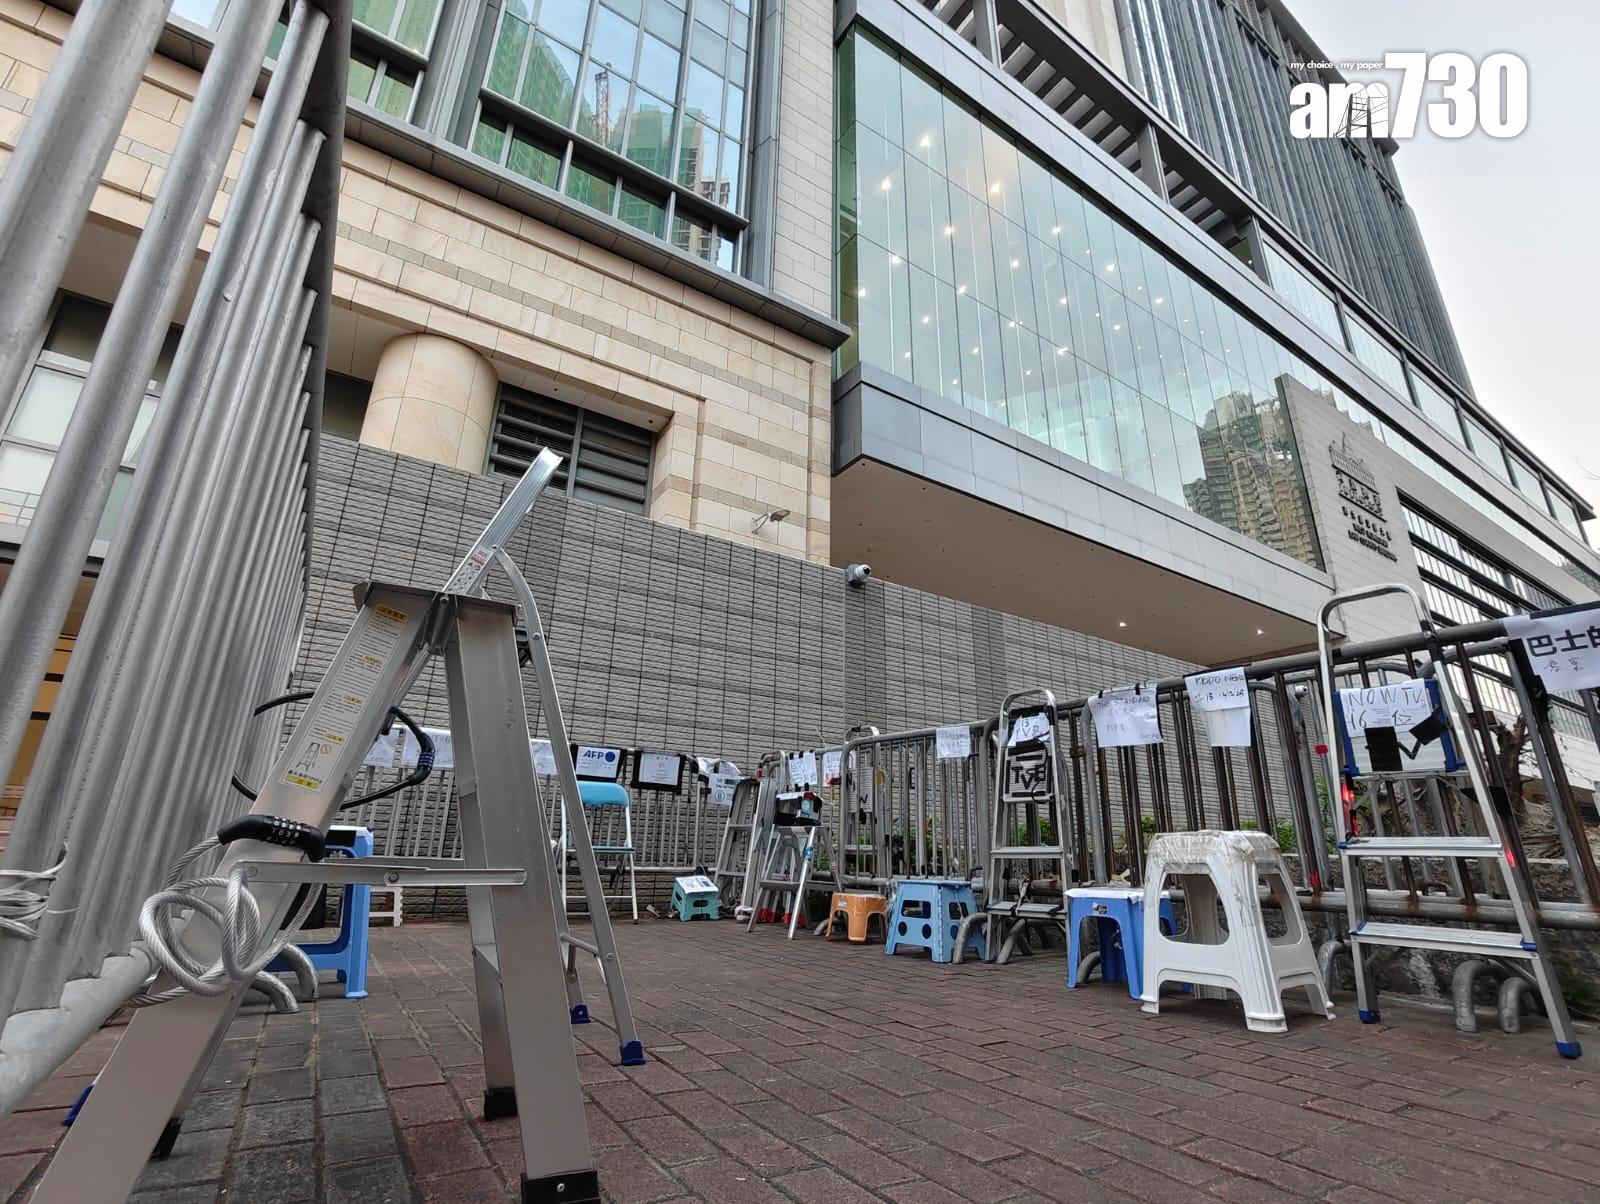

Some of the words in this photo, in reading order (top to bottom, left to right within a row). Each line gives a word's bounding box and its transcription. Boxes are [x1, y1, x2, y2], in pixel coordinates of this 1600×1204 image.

[1348, 687, 1397, 706] NOW
[1401, 687, 1423, 706] TV
[582, 750, 605, 760] AFP
